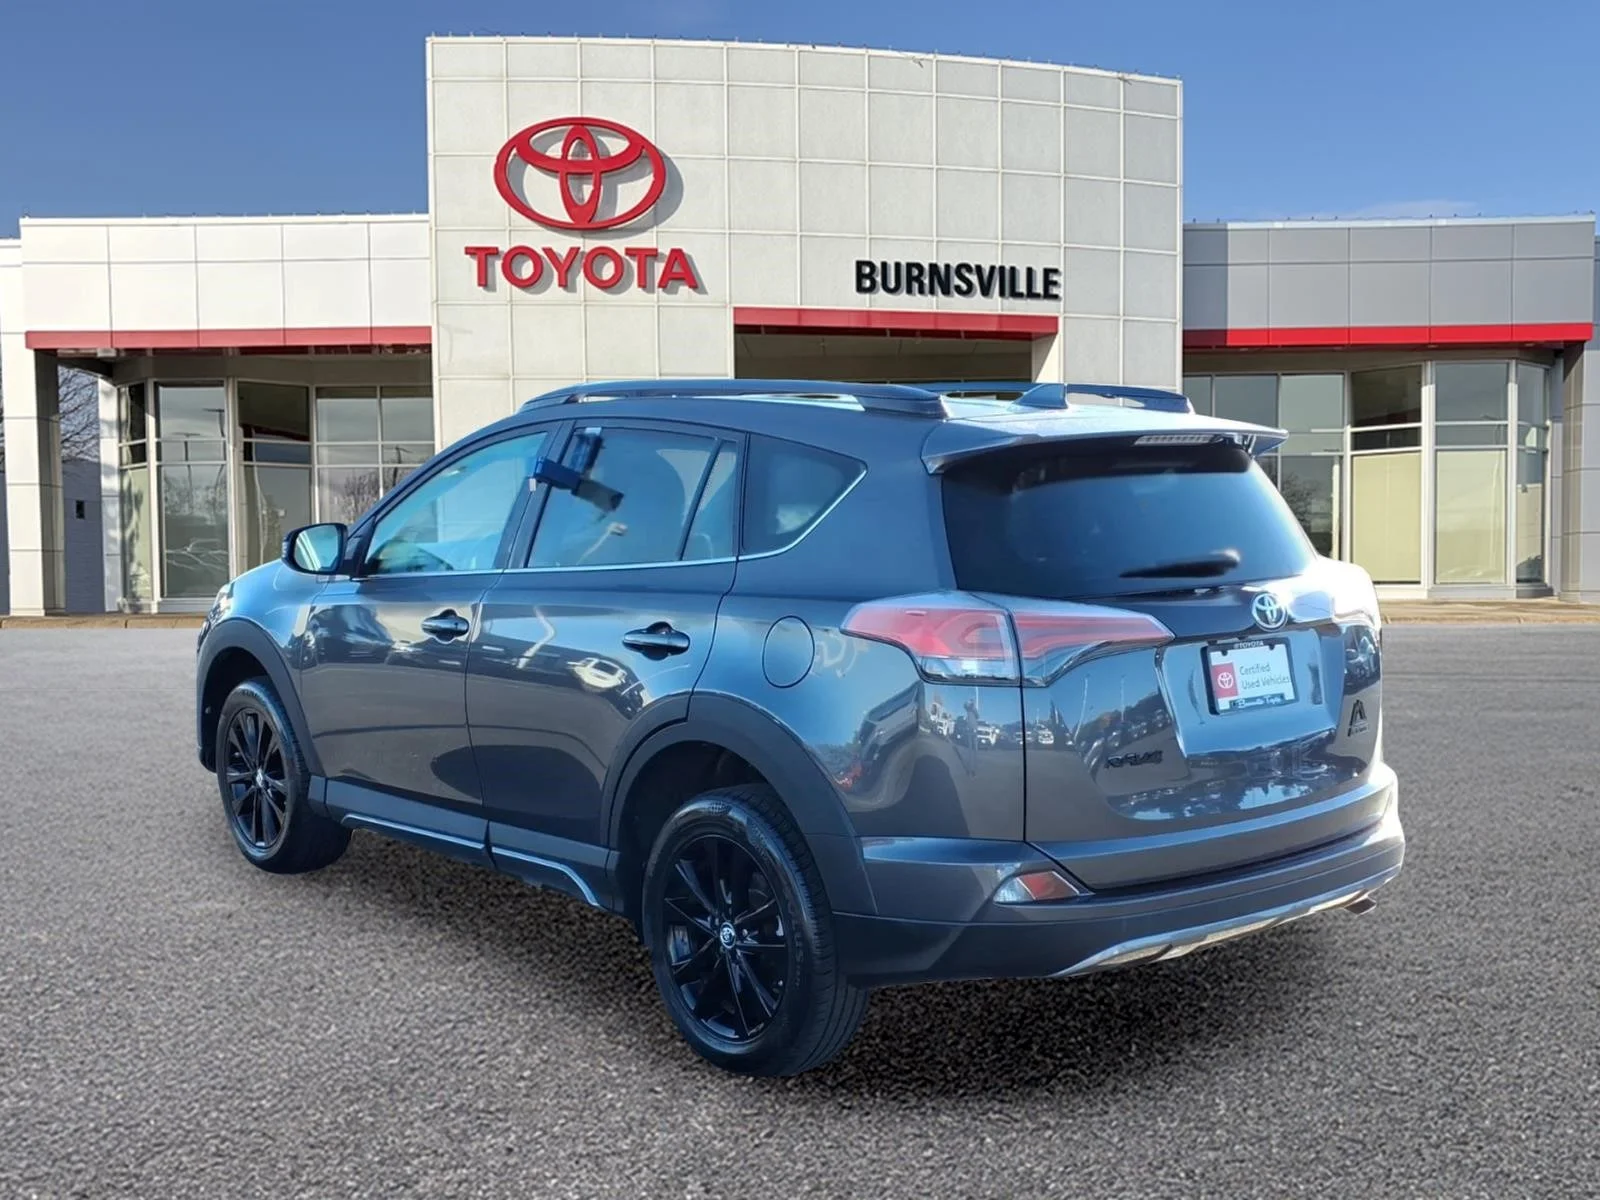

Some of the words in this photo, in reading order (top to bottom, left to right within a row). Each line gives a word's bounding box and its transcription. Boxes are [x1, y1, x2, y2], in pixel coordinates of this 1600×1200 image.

[464, 245, 698, 289] TOYOTA
[855, 260, 1062, 300] BURNSVILLE
[1239, 662, 1271, 675] Certified
[1241, 679, 1260, 690] Used
[1262, 675, 1290, 687] Vehicles
